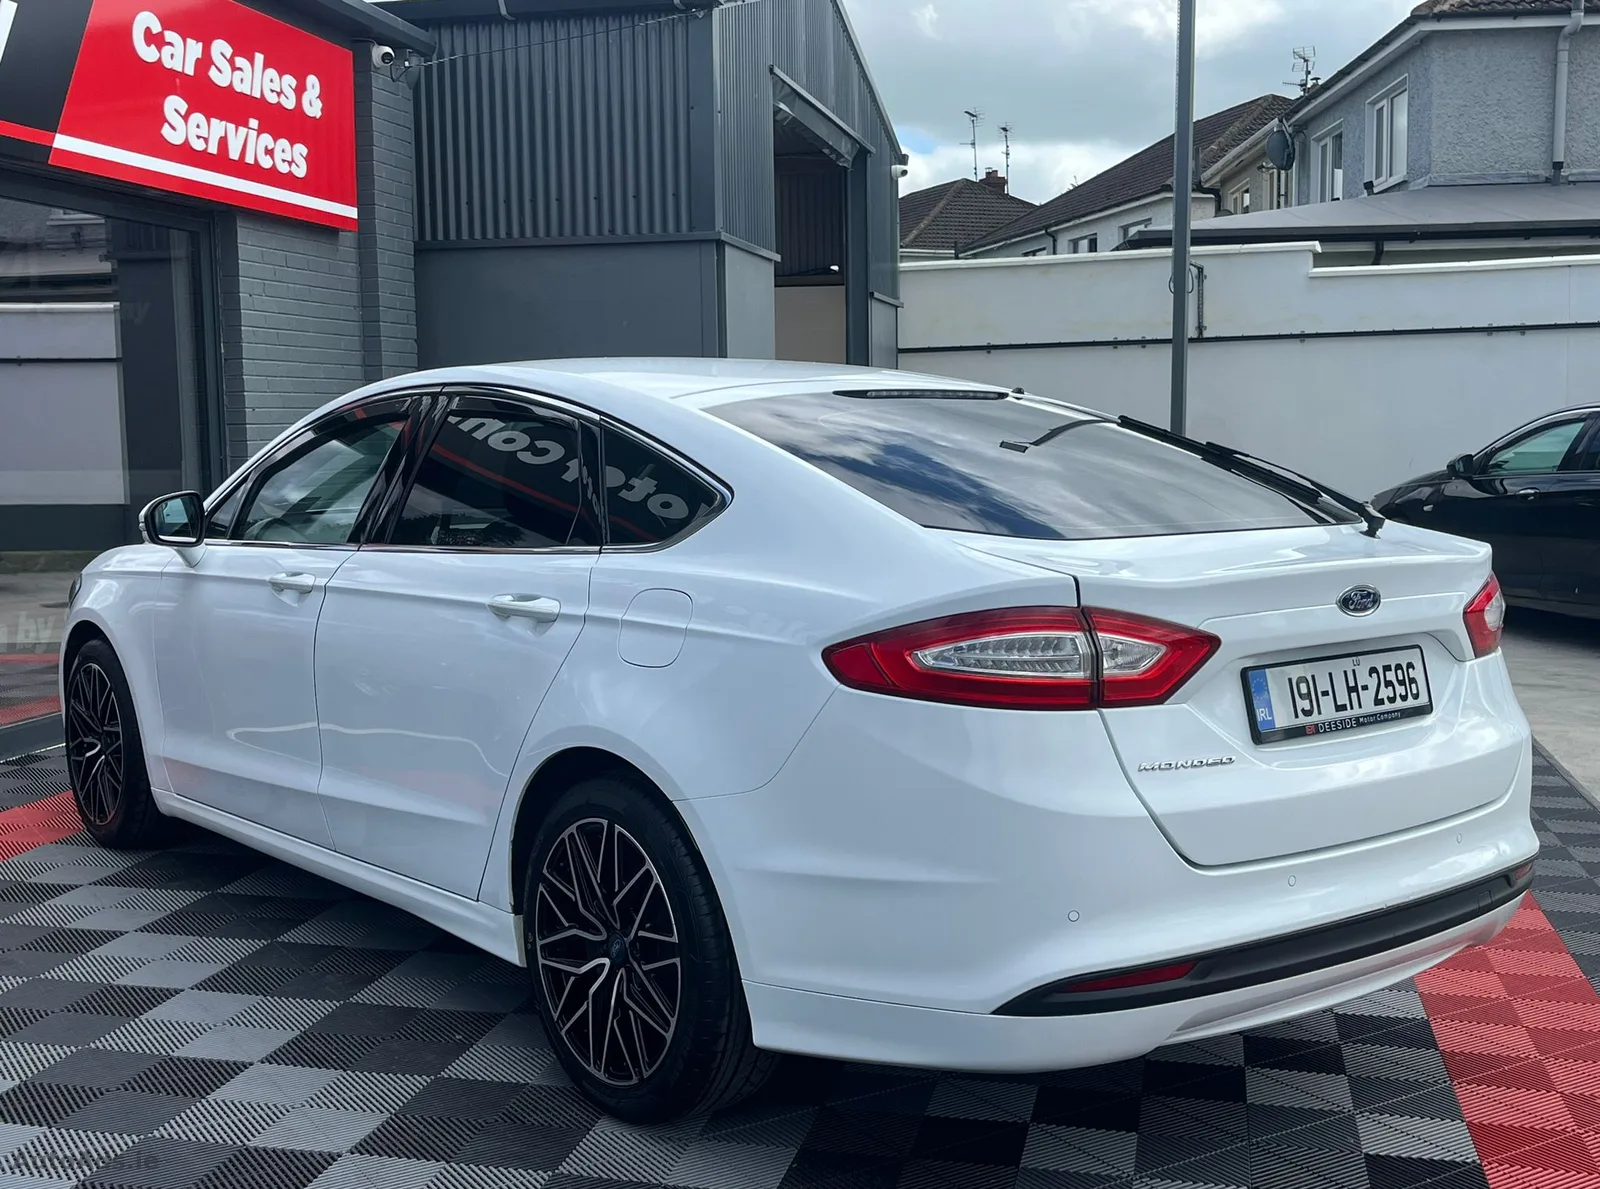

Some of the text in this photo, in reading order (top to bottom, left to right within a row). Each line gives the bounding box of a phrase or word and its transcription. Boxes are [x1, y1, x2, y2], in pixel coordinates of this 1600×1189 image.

[132, 11, 323, 119] Car Sales &
[160, 95, 308, 178] Services
[1287, 661, 1420, 719] 191-LH-2596
[1257, 707, 1273, 722] IRL
[1318, 717, 1357, 733] DEESIDE
[1377, 711, 1401, 722] Company
[1138, 756, 1236, 772] MONDEO
